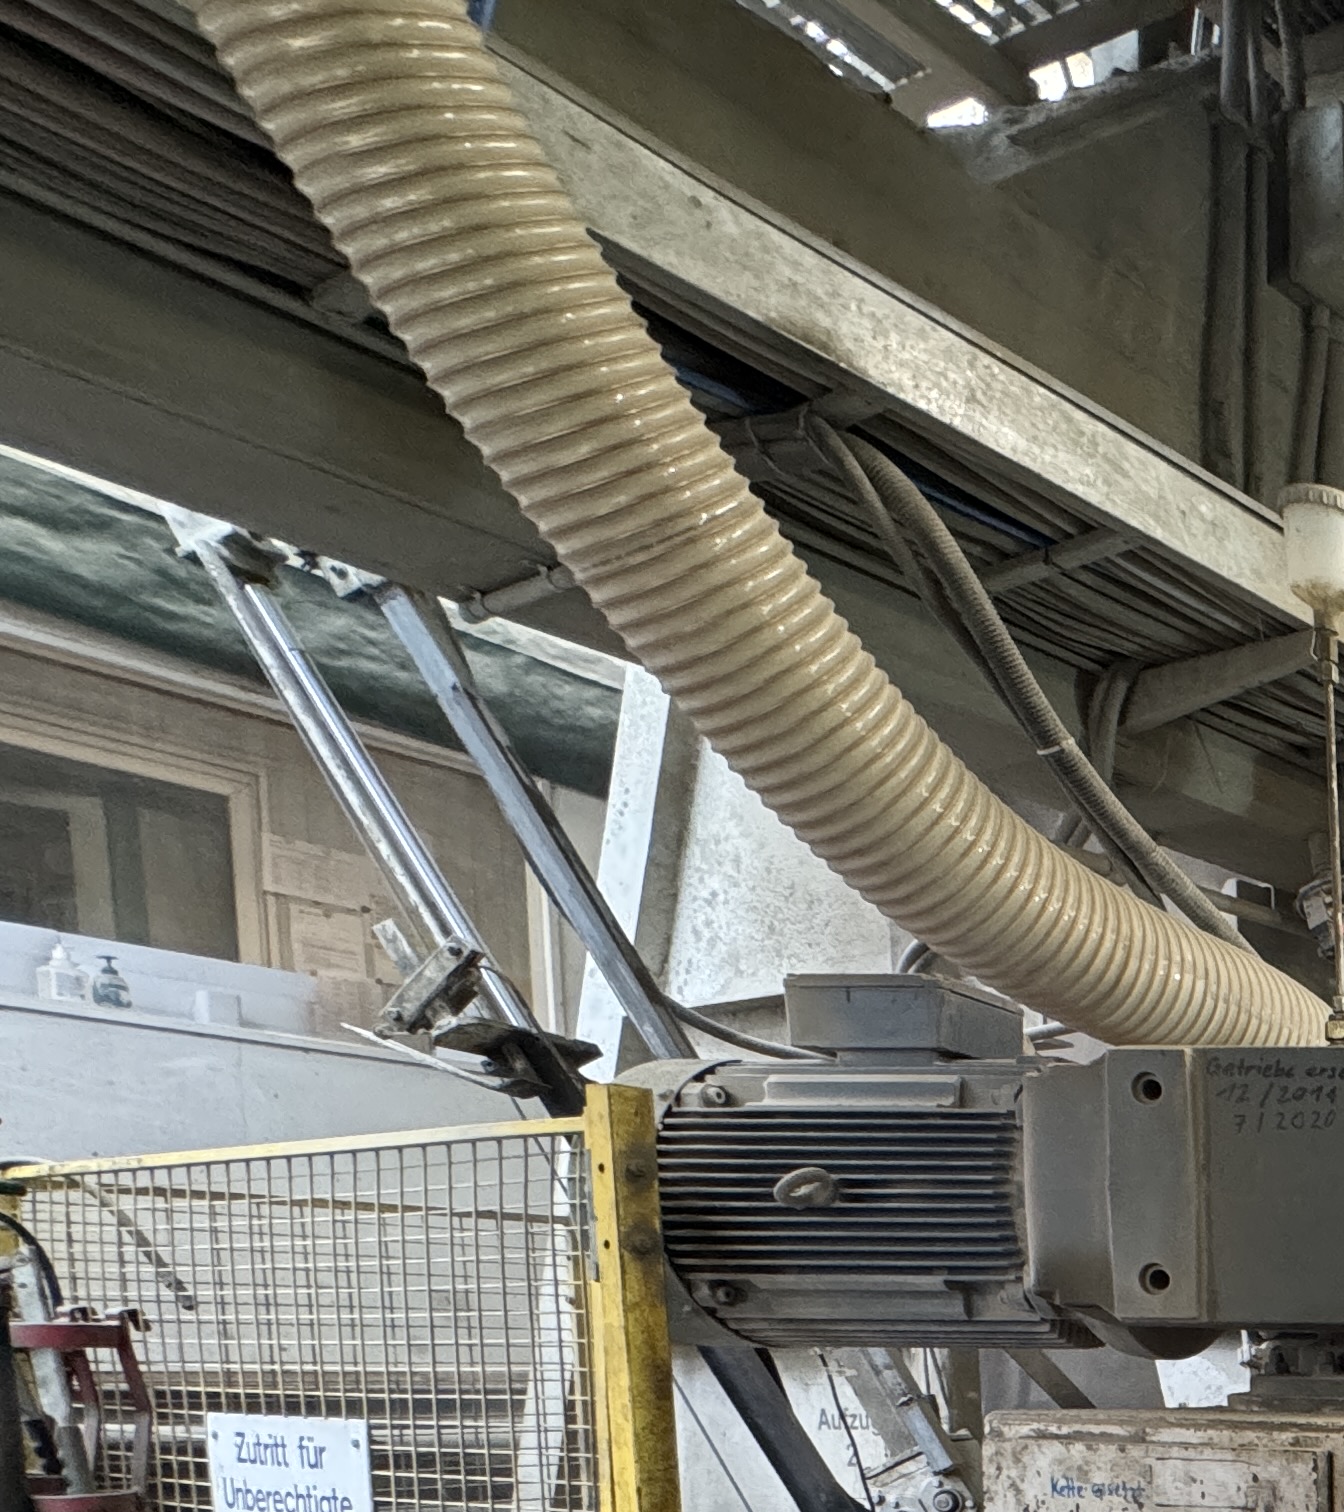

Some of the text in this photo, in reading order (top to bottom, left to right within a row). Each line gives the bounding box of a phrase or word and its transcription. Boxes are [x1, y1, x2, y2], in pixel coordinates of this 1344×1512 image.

[818, 1407, 881, 1436] Auzu
[234, 1432, 326, 1470] Zutritt für
